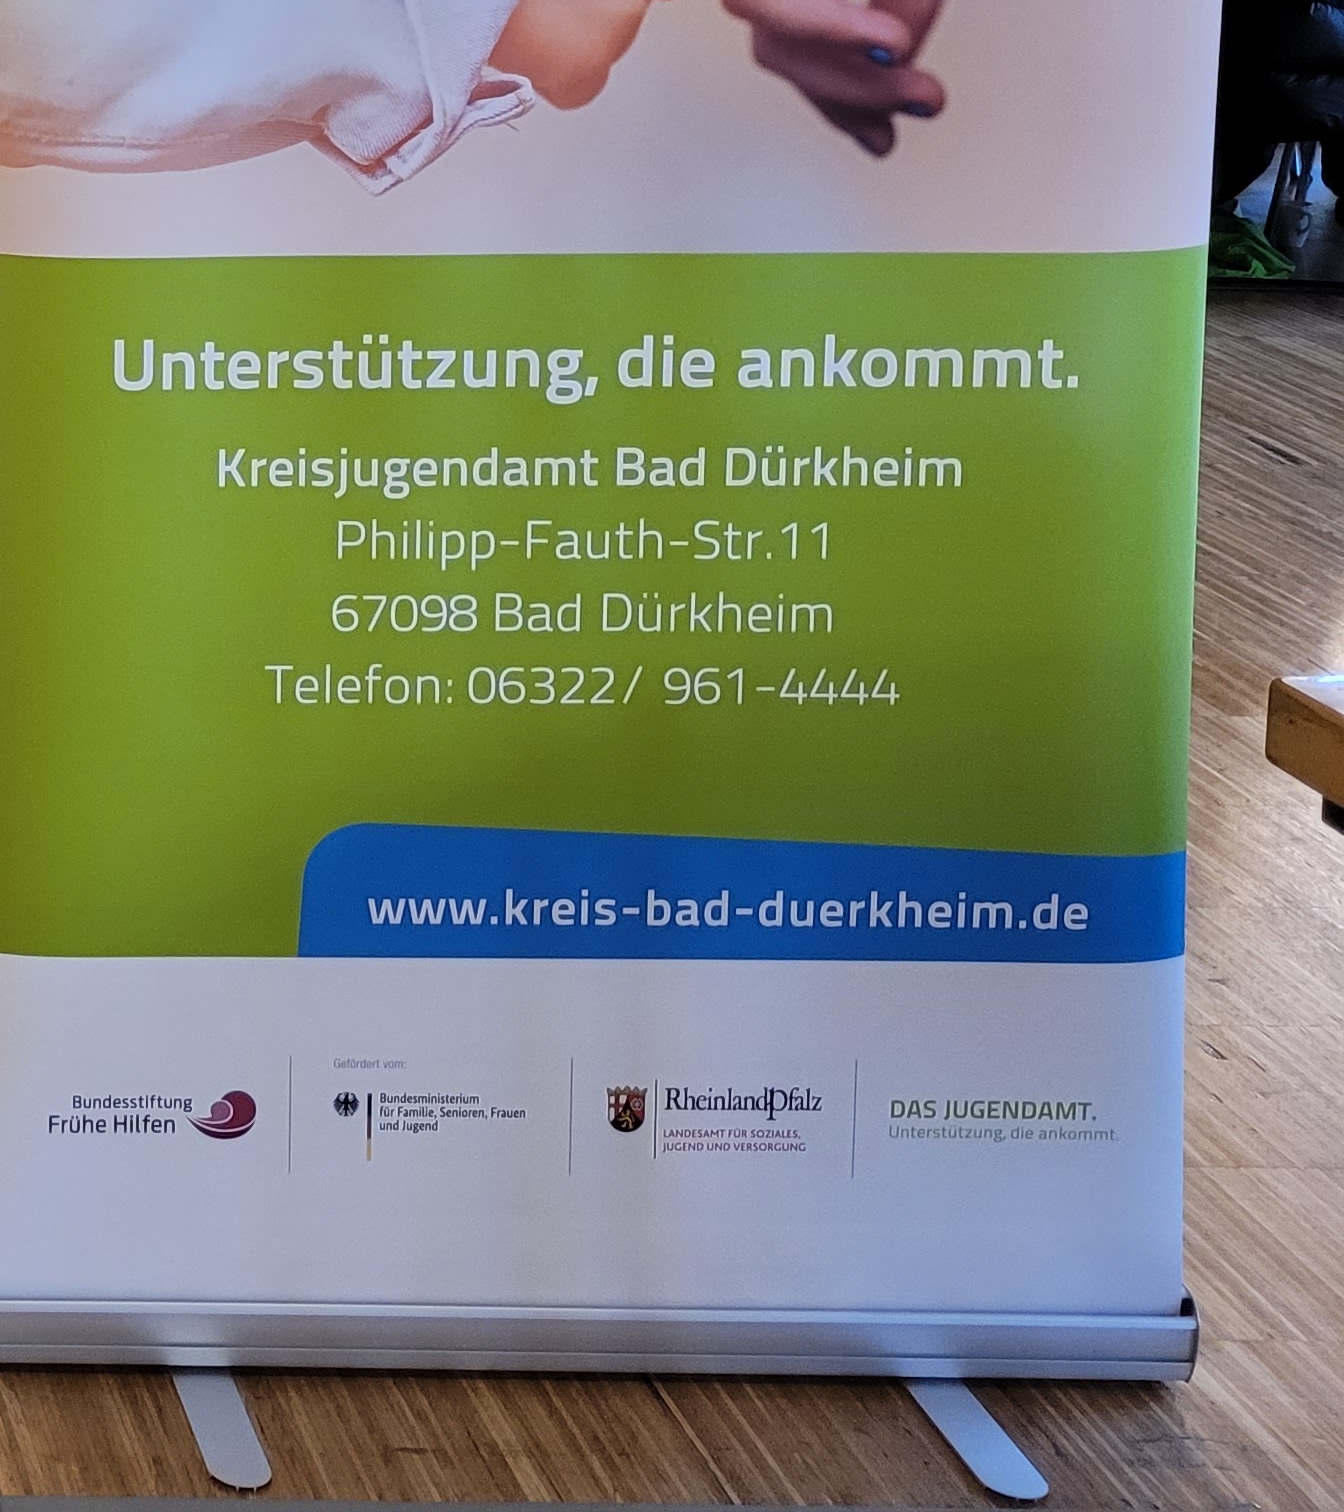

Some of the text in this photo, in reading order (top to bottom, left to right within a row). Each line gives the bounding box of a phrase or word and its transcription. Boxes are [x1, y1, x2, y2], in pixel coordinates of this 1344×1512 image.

[114, 334, 1078, 404] Unterstützung, die ankommt.
[219, 446, 961, 499] Kreisjugendamt Bad Dürkheim
[338, 518, 831, 570] Philipp-Fauth-Str.11
[332, 592, 832, 632] 67098 Bad Dürkheim
[265, 664, 900, 705] Telefon: 06322/ 961-4444
[368, 889, 1088, 929] www.kreis-bad-duerkheim.de
[333, 1058, 380, 1069] Gefördert
[73, 1095, 192, 1112] Bundesstiftung
[380, 1093, 479, 1104] Bundesministerium
[380, 1106, 525, 1119] für Familie, Senioren, Frauen
[891, 1100, 1096, 1120] DAS JUGENDAMT.
[49, 1114, 175, 1133] Frühe Hilfen
[380, 1120, 438, 1133] und Jugend
[664, 1127, 800, 1139] LANDESAMT FÜR SOZIALES,
[889, 1126, 1006, 1143] Unterstützung,
[1011, 1127, 1033, 1139] die
[663, 1143, 806, 1153] JUGEND UND VERSORGUNG
